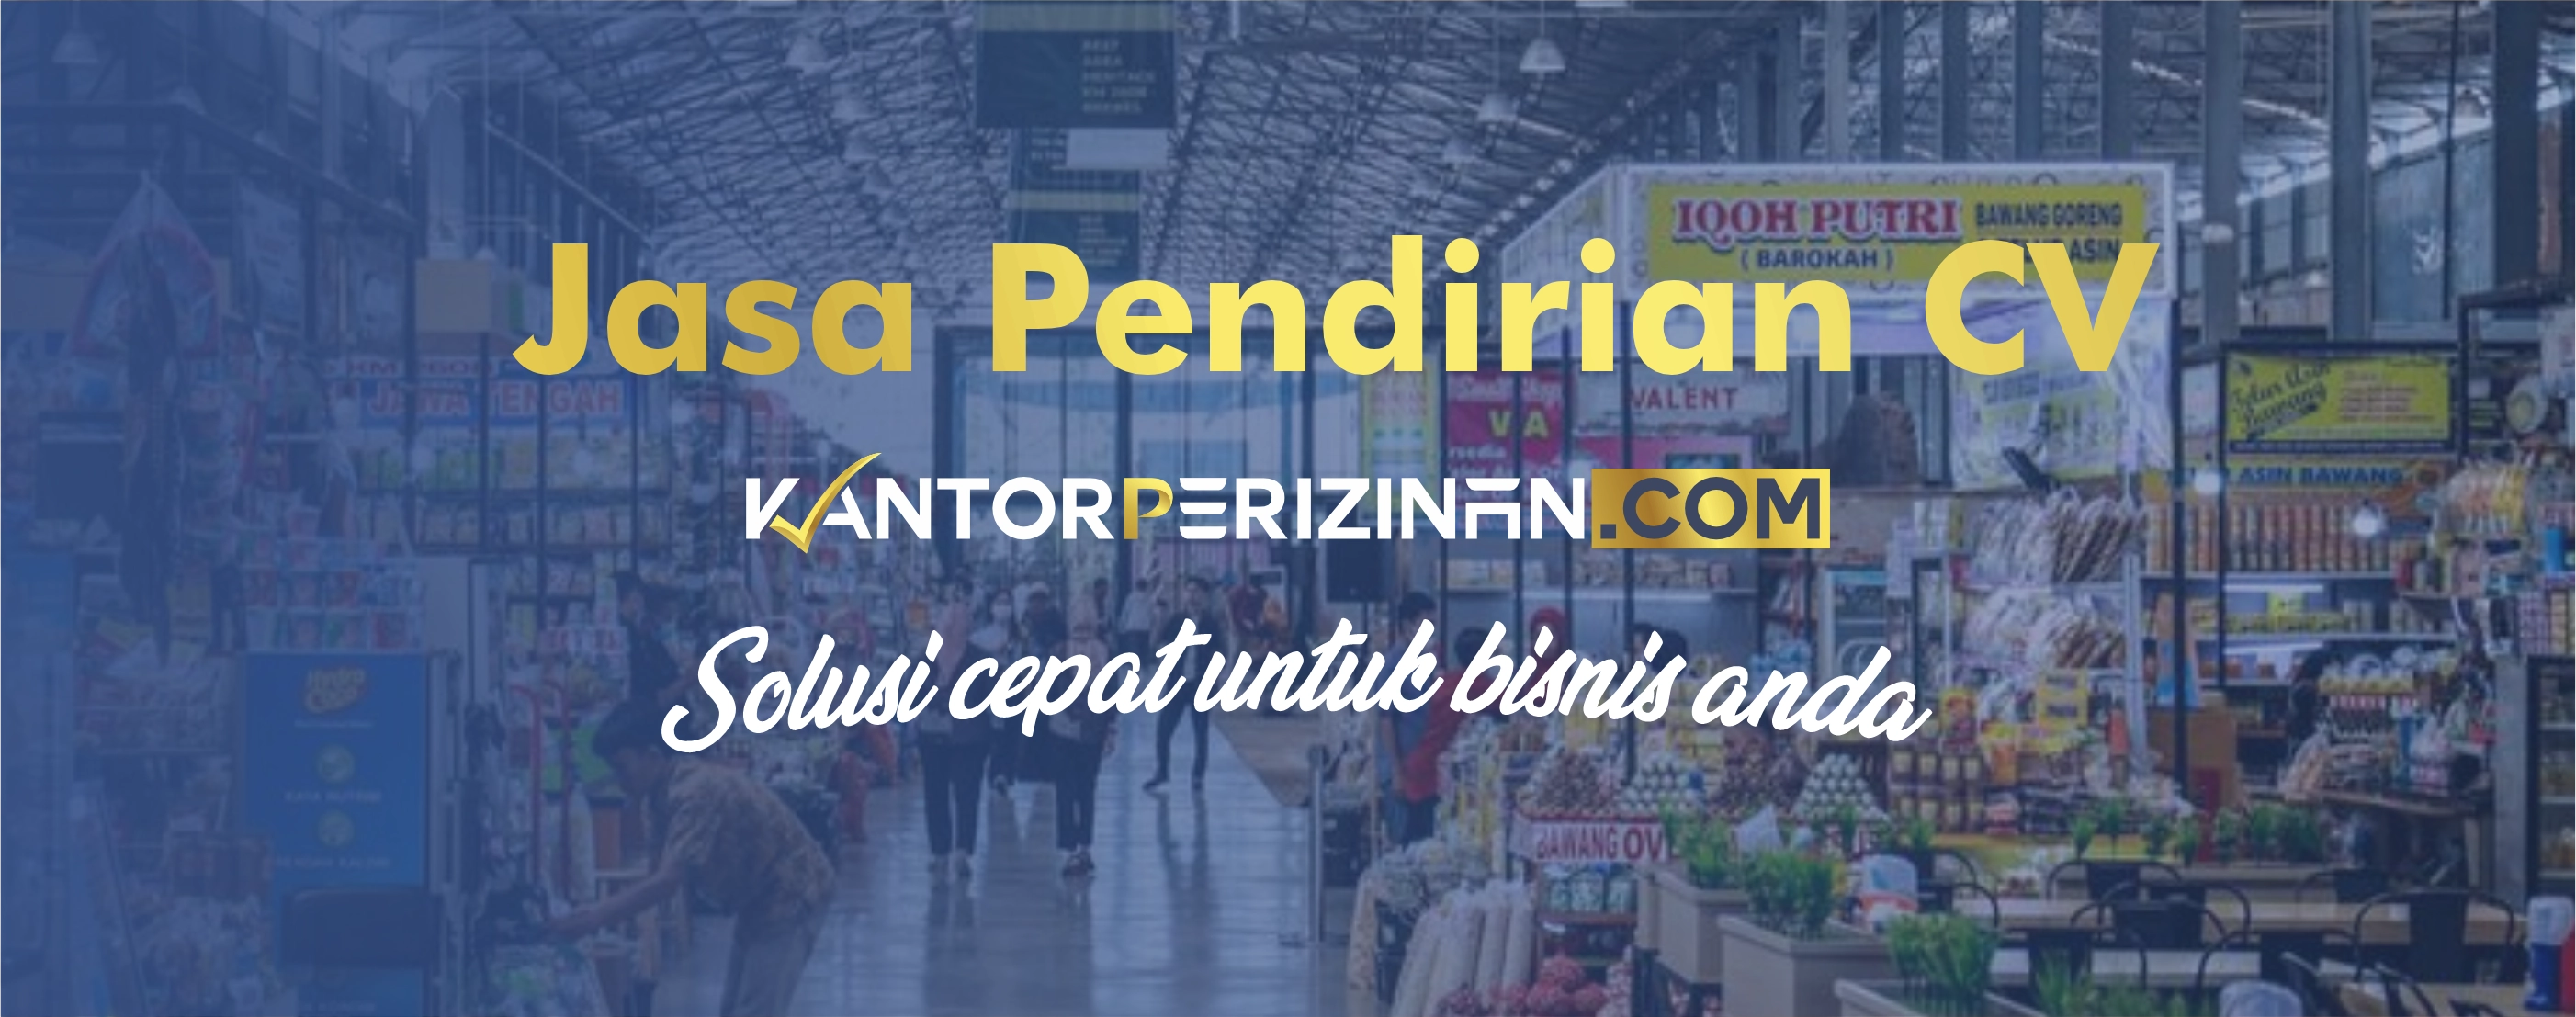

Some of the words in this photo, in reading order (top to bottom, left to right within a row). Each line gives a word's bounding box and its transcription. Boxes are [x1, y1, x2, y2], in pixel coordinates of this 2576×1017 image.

[1677, 198, 1800, 245] IQOH
[1811, 198, 1960, 236] PUTRI
[1976, 202, 2049, 226] BAWANG
[2052, 202, 2122, 226] GORENG
[1630, 387, 1739, 410] VALENT
[2300, 467, 2404, 486] BAWANG
